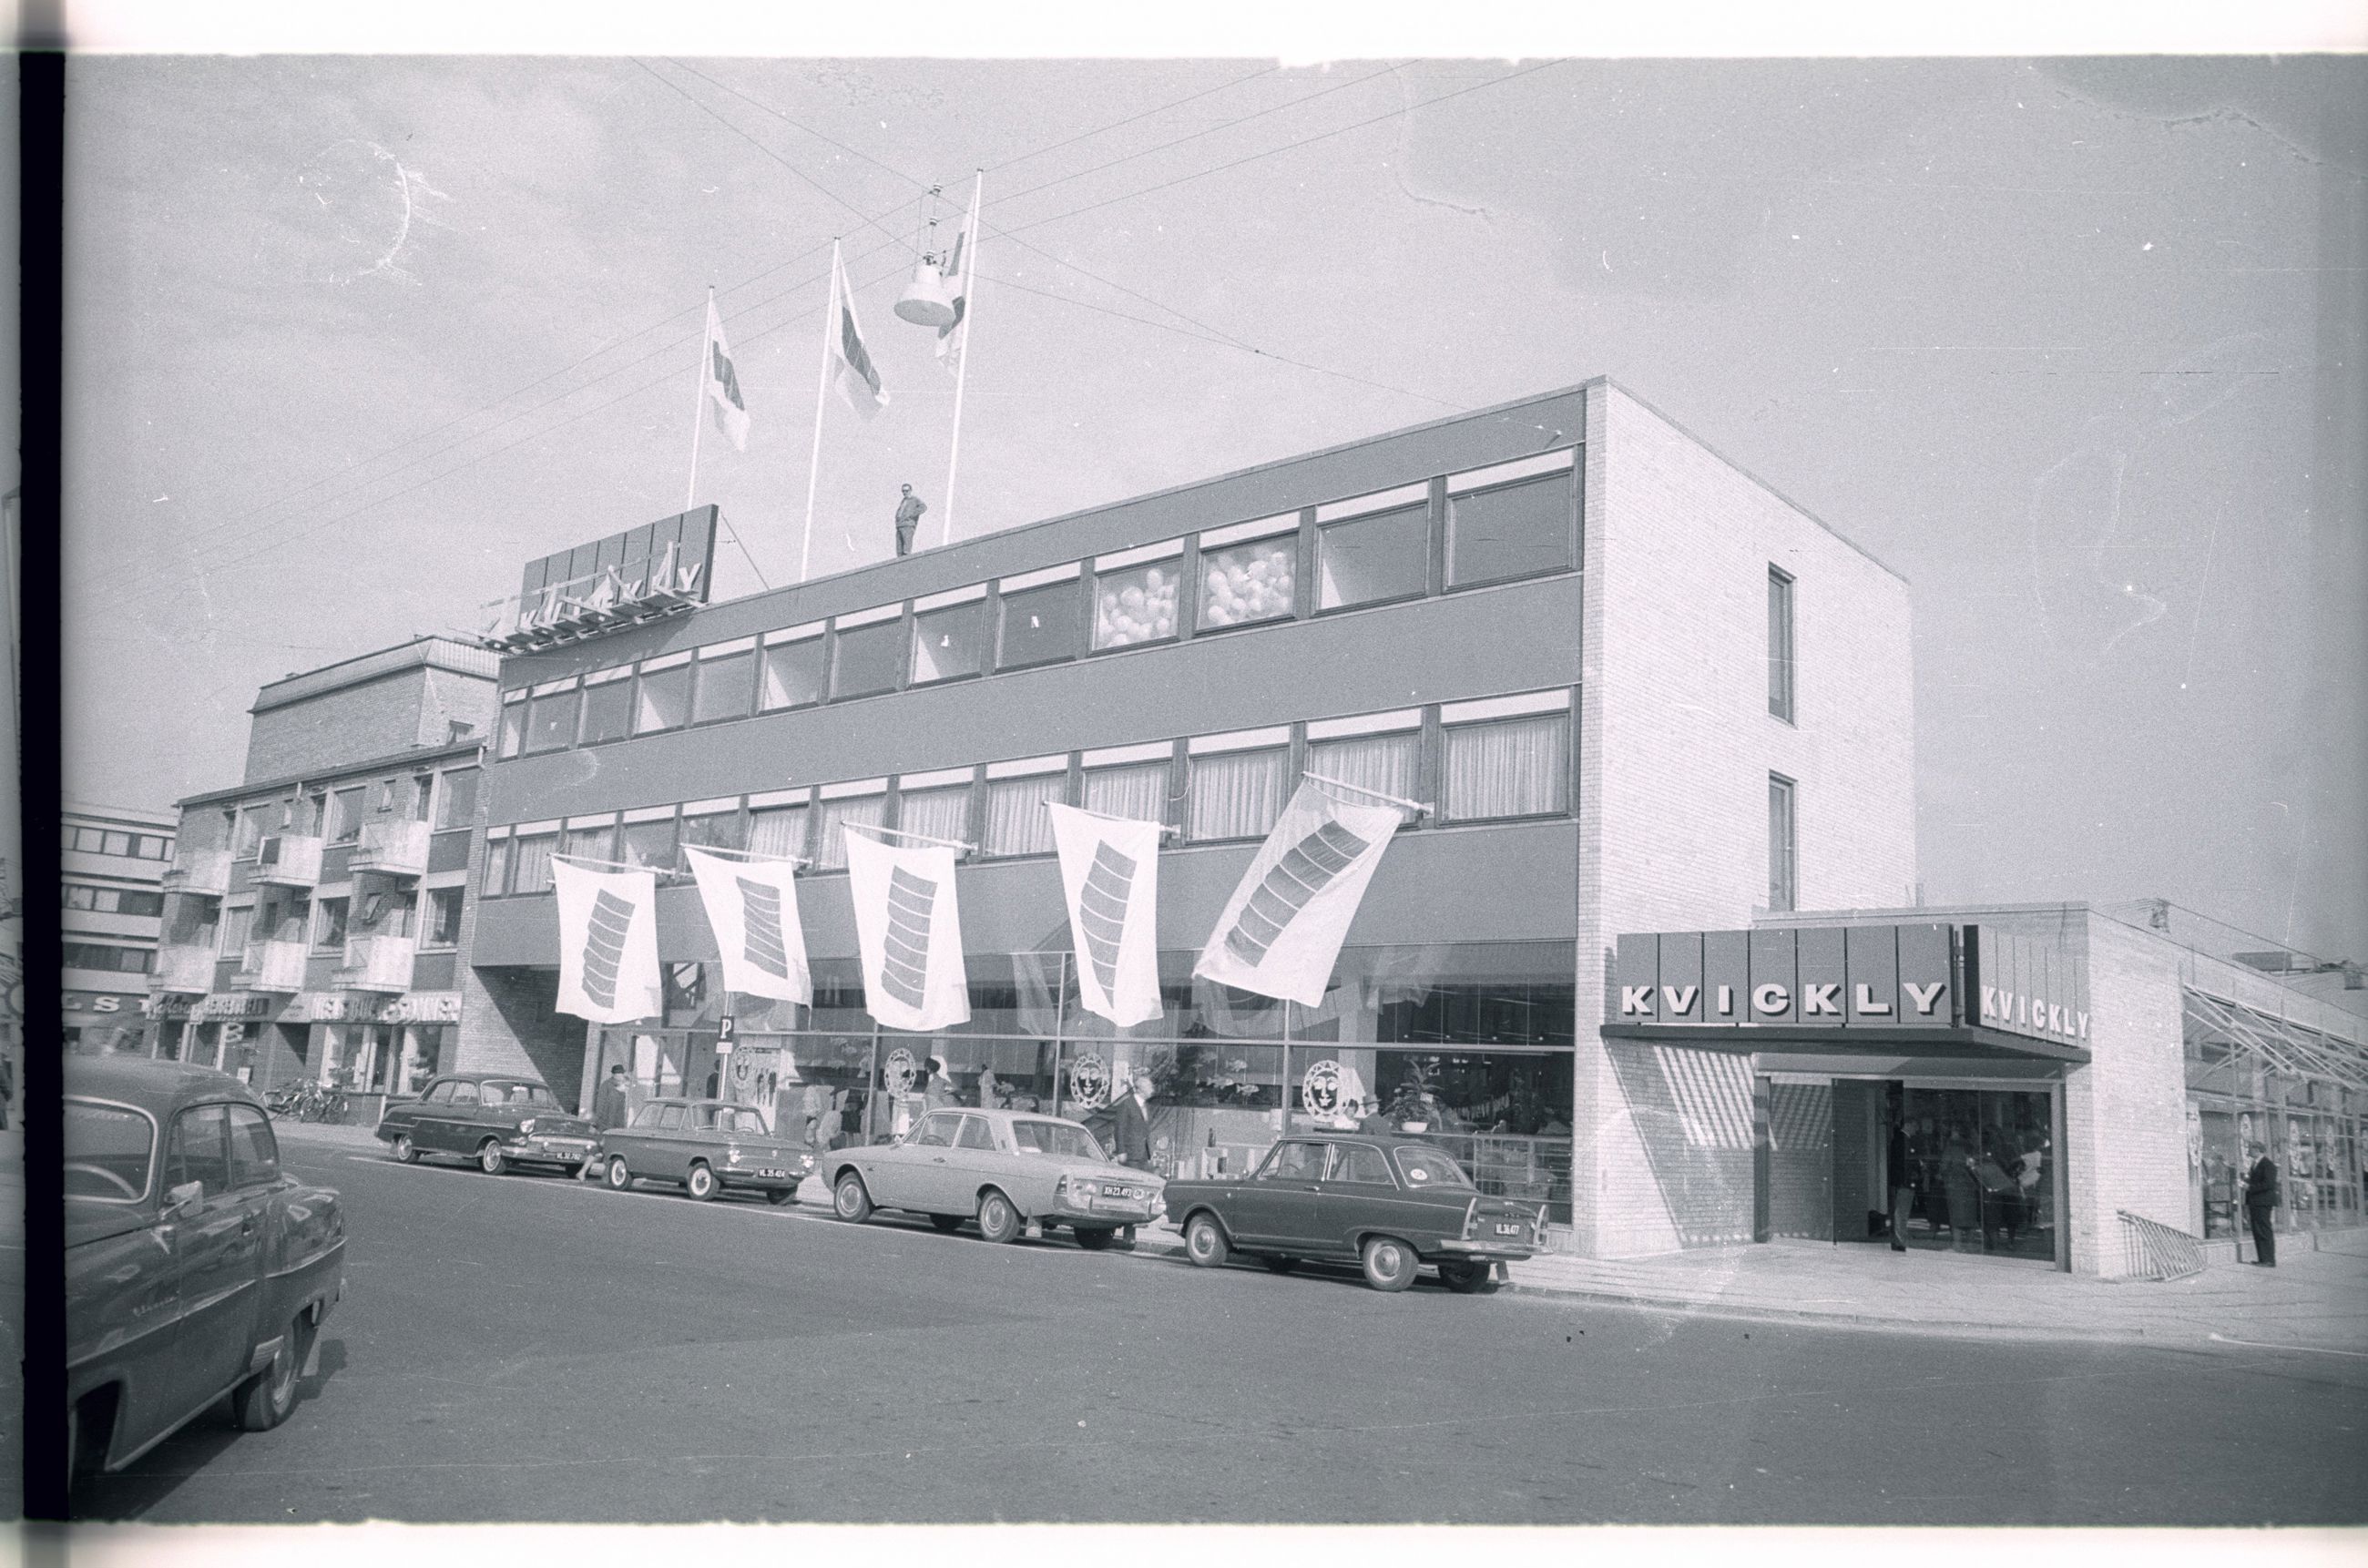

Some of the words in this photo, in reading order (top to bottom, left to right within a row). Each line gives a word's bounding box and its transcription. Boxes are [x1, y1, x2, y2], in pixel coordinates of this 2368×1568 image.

[1621, 983, 1944, 1014] KVICKLY
[1982, 984, 2089, 1039] KVICKLY
[720, 1018, 732, 1039] P
